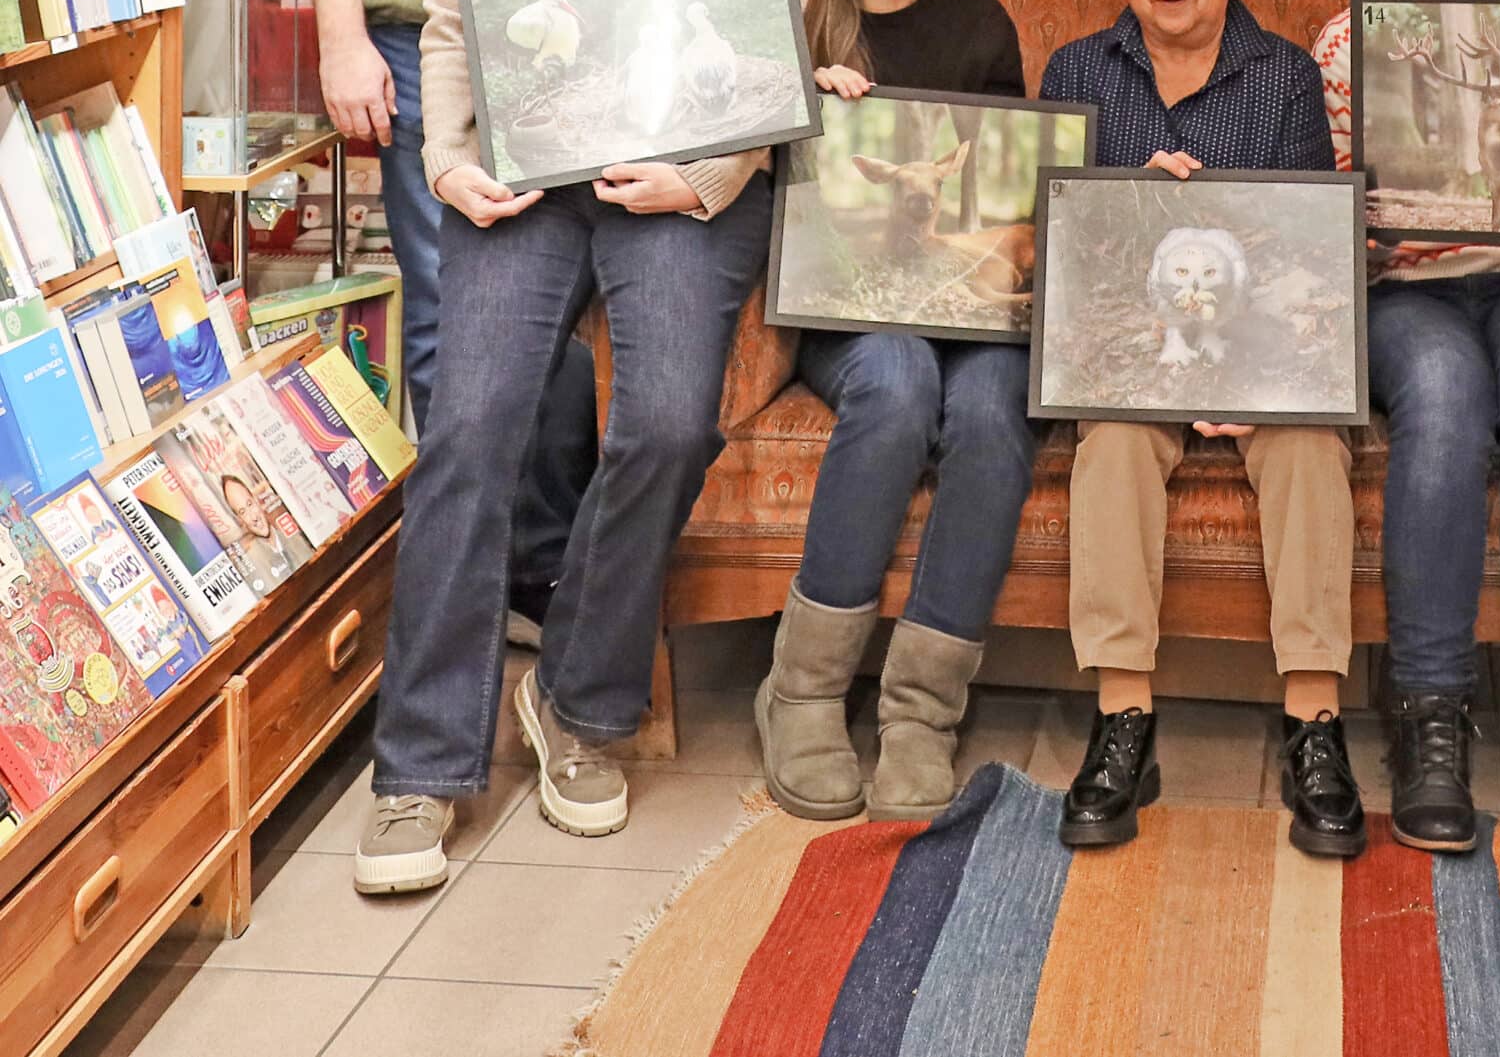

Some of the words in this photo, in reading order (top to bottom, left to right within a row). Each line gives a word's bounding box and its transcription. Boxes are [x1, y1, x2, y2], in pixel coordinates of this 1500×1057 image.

[1364, 5, 1385, 24] 14
[122, 467, 146, 489] PETER
[117, 496, 161, 551] EWIGKEIT
